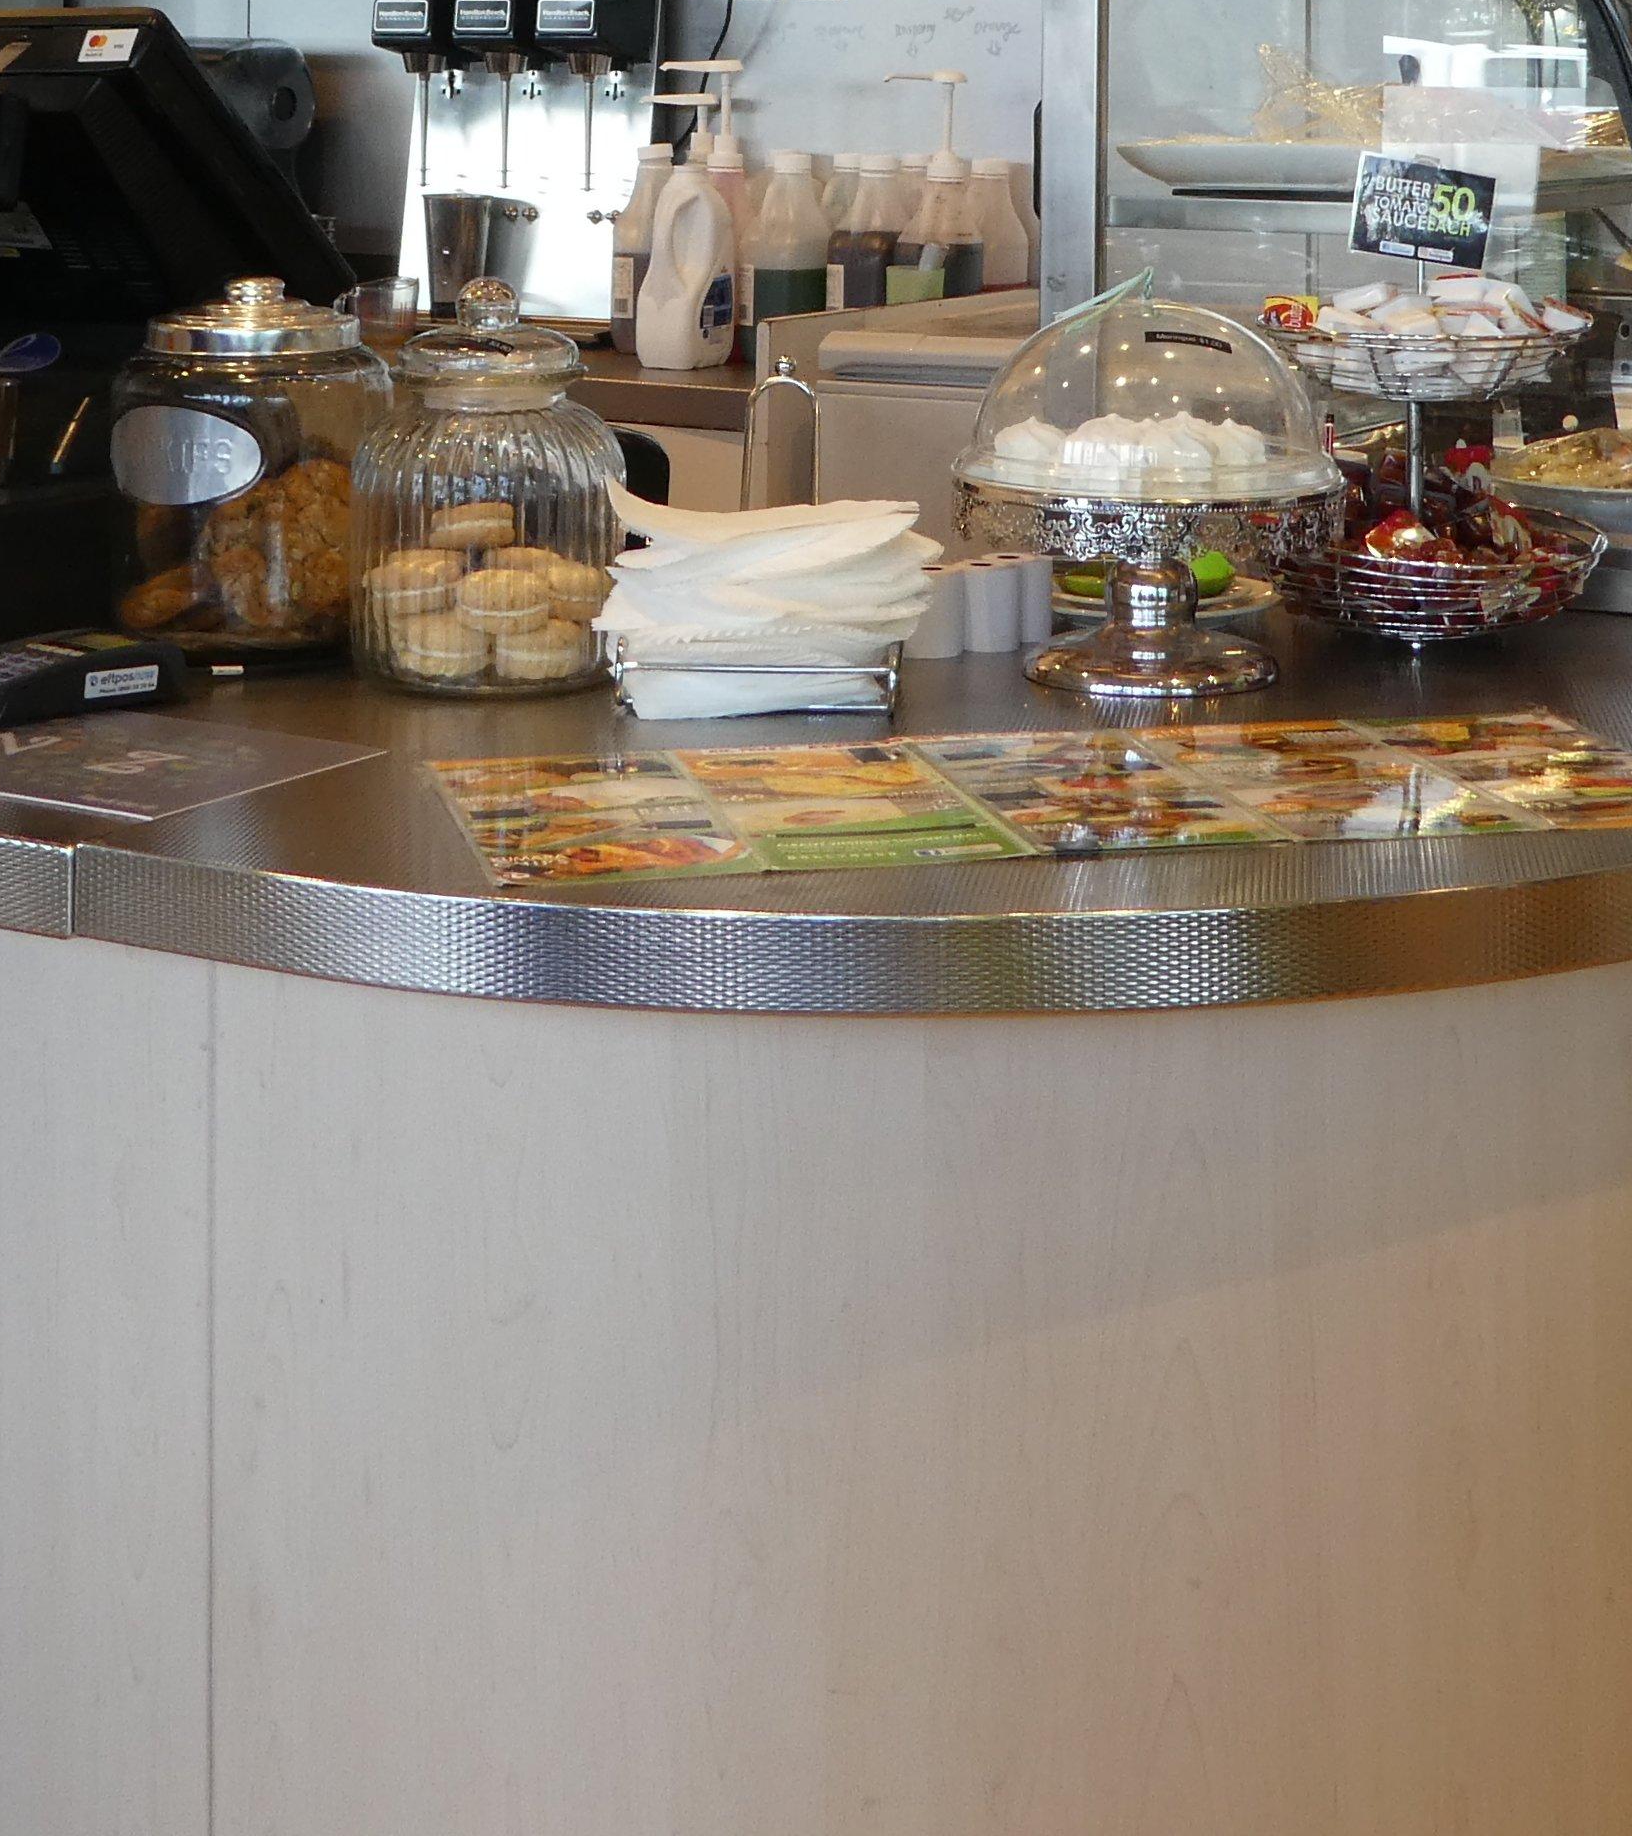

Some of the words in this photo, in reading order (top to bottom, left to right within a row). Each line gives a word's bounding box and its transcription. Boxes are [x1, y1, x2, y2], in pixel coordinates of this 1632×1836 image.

[1375, 176, 1431, 198] BUTTER
[1374, 195, 1428, 214] TOMATO
[1432, 183, 1475, 221] 50
[1372, 208, 1428, 230] SAUCE
